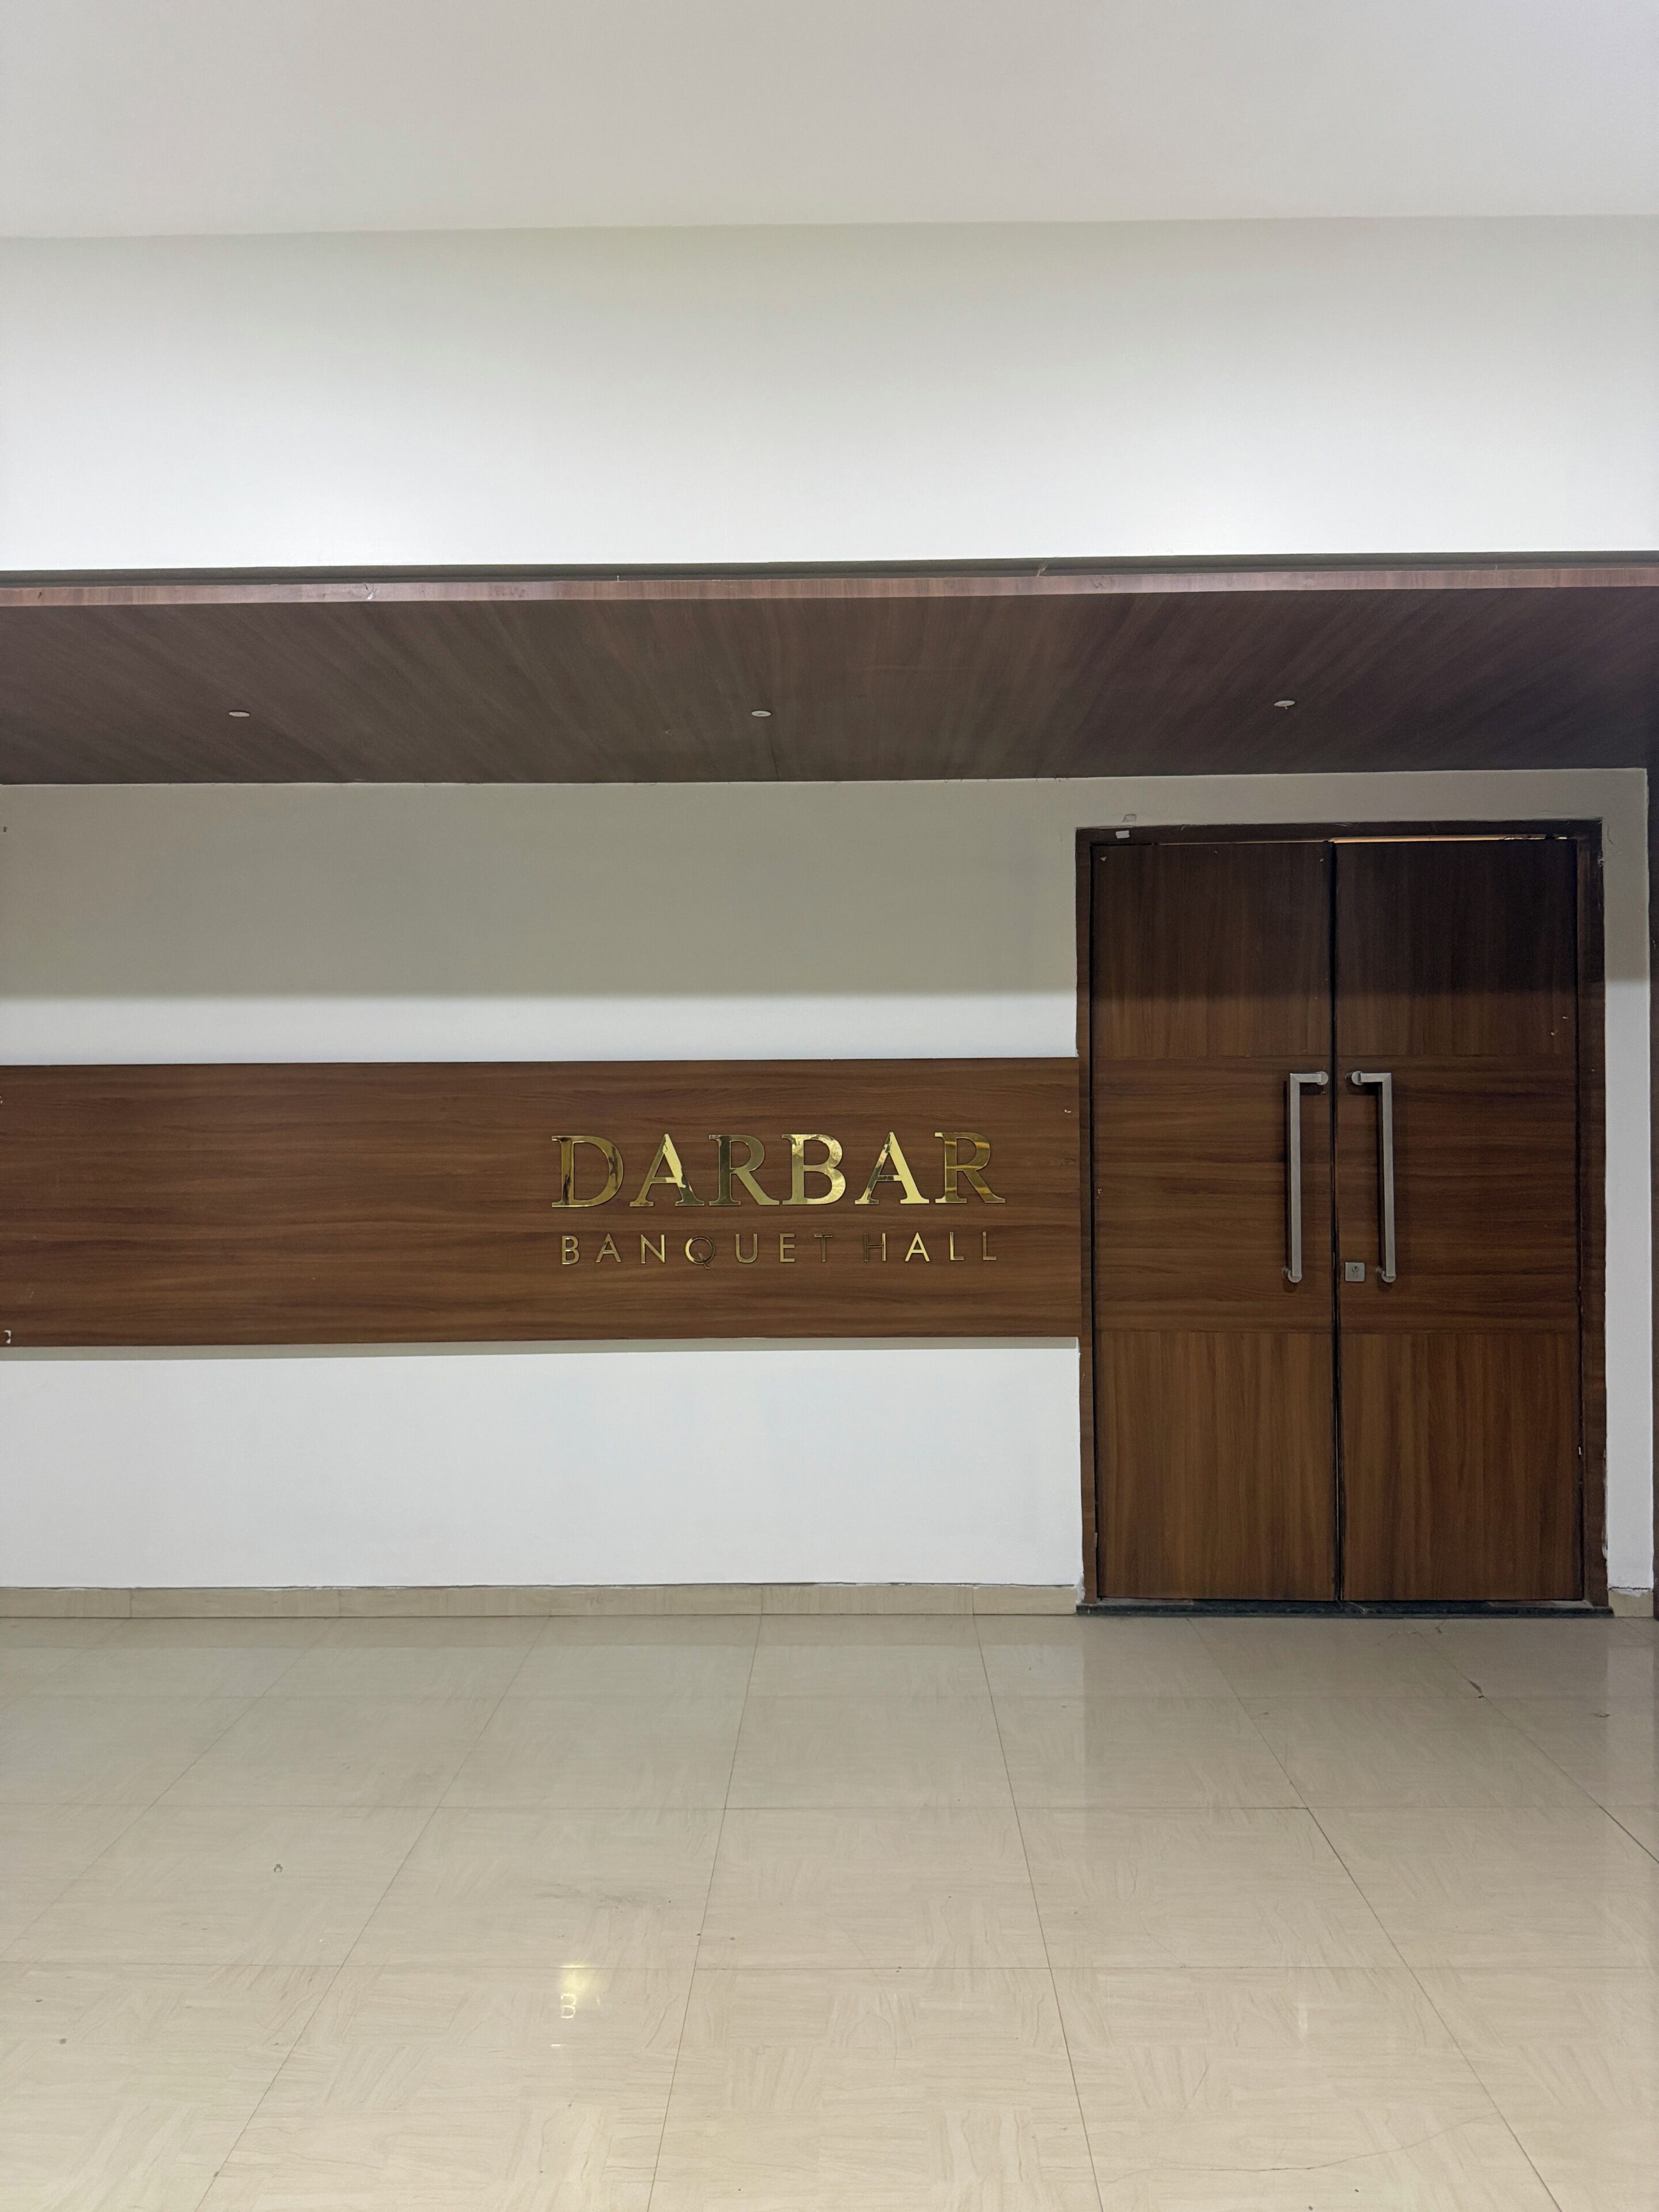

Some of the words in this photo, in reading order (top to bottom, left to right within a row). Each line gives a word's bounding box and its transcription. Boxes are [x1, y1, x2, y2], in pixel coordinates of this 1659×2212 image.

[551, 1132, 1006, 1207] DARBAR
[561, 1233, 834, 1269] BANQUET
[864, 1232, 997, 1262] HALL
